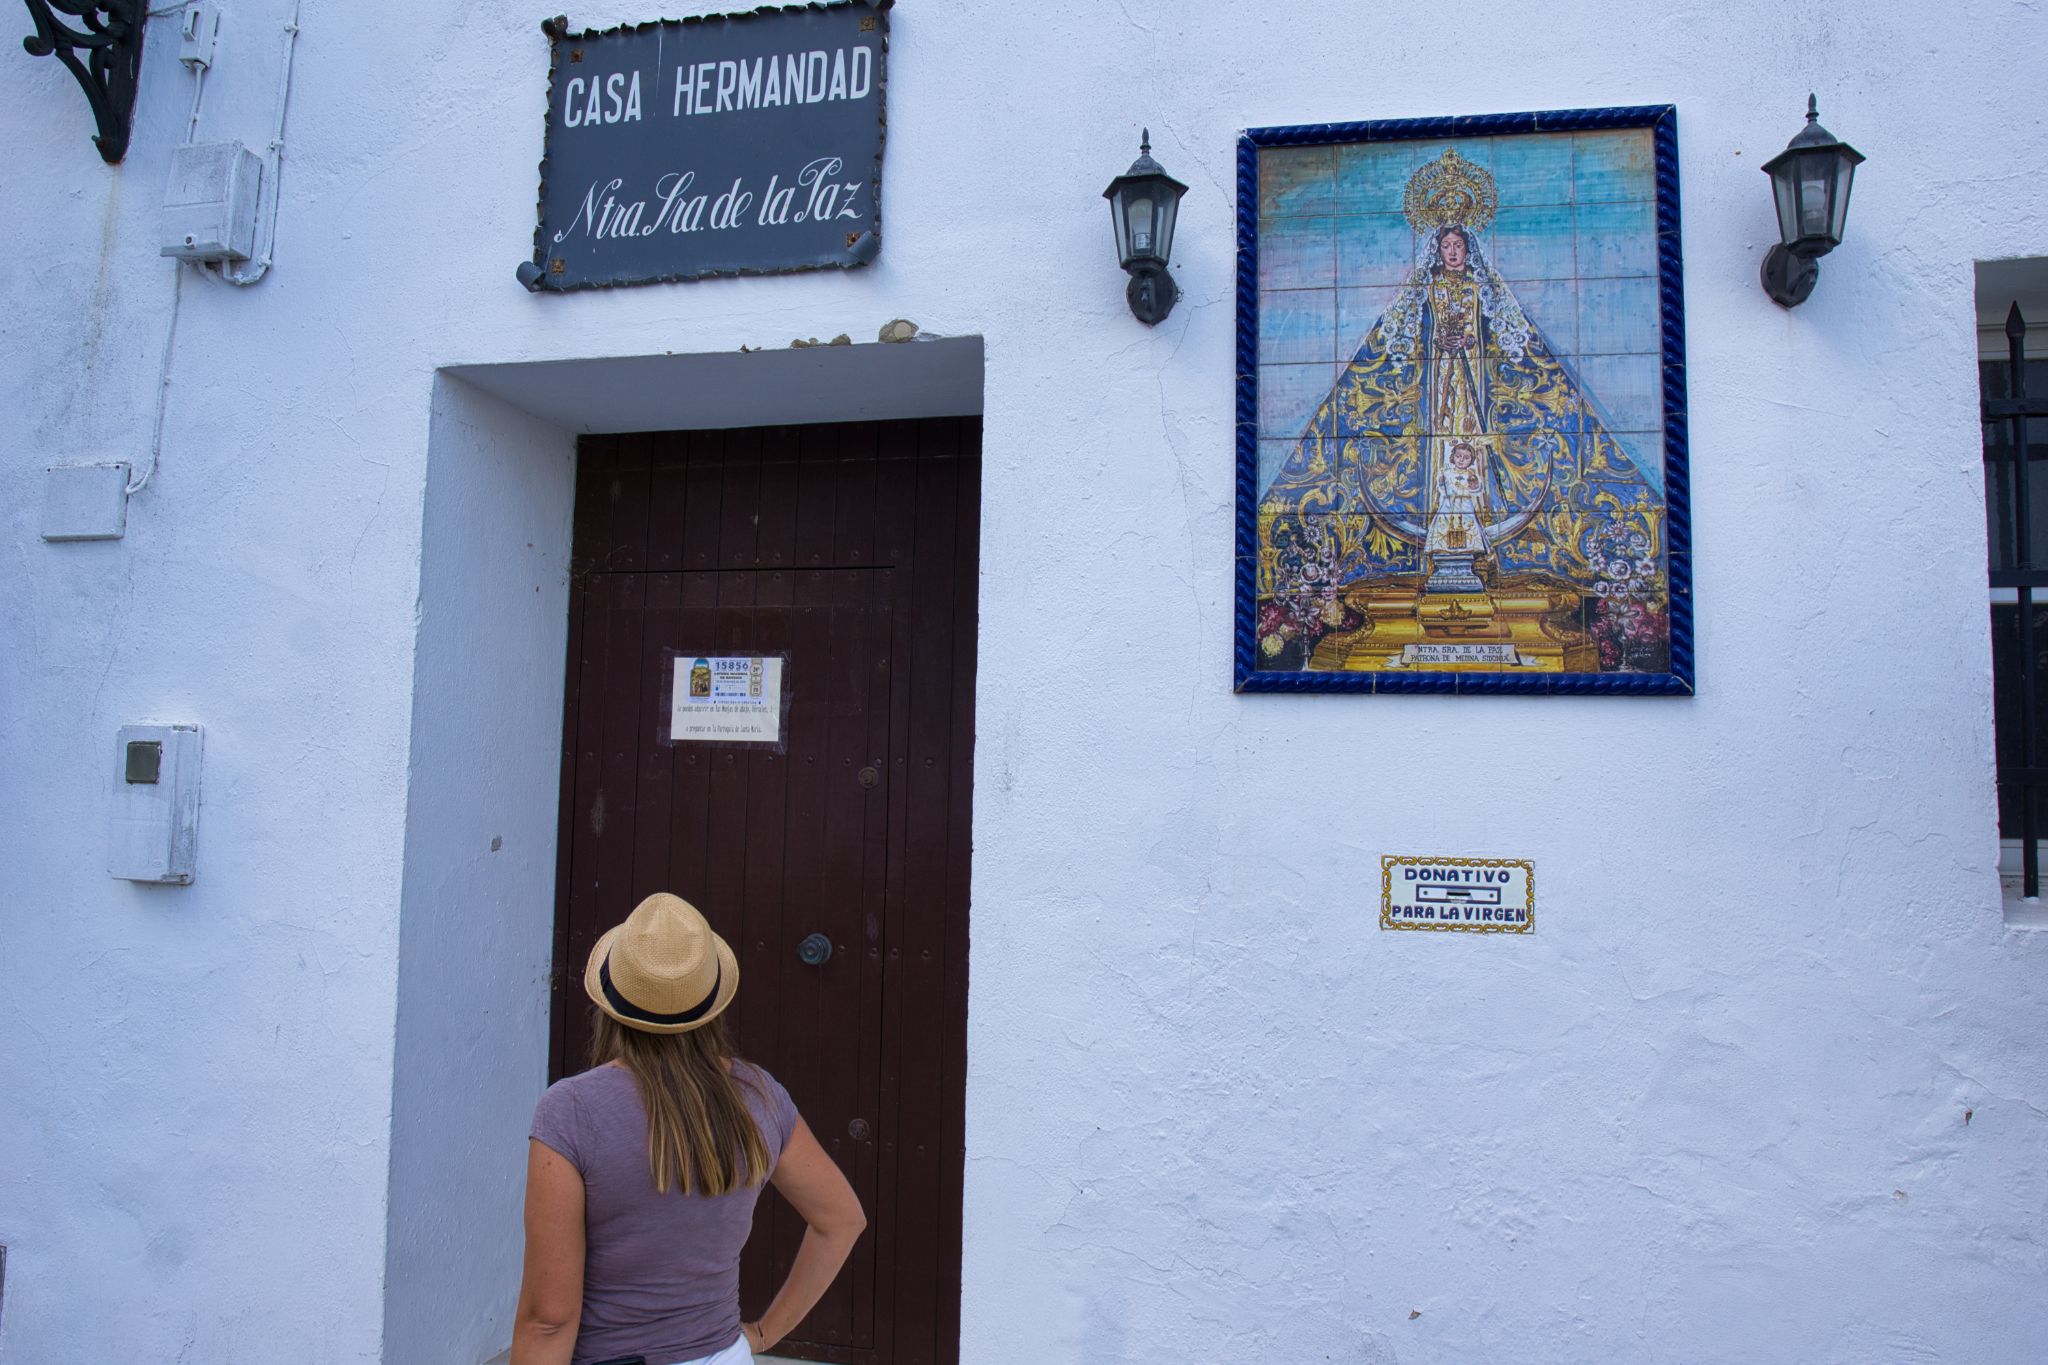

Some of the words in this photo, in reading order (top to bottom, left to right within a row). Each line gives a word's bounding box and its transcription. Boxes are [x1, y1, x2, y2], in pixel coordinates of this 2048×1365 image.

[564, 70, 642, 128] CASA
[673, 46, 872, 117] HERMANDAD
[553, 178, 643, 243] Ntra.
[642, 171, 707, 236] Sra.
[710, 177, 753, 229] de
[758, 174, 796, 227] la
[794, 157, 863, 223] Paz
[1463, 645, 1472, 654] DE
[1475, 645, 1486, 654] LA
[1488, 645, 1503, 654] PAZ
[715, 661, 749, 671] 15856
[1404, 868, 1511, 883] DONATIVO
[1392, 905, 1435, 919] PARA
[1439, 906, 1460, 920] LA
[1463, 907, 1526, 922] VIRGEN
